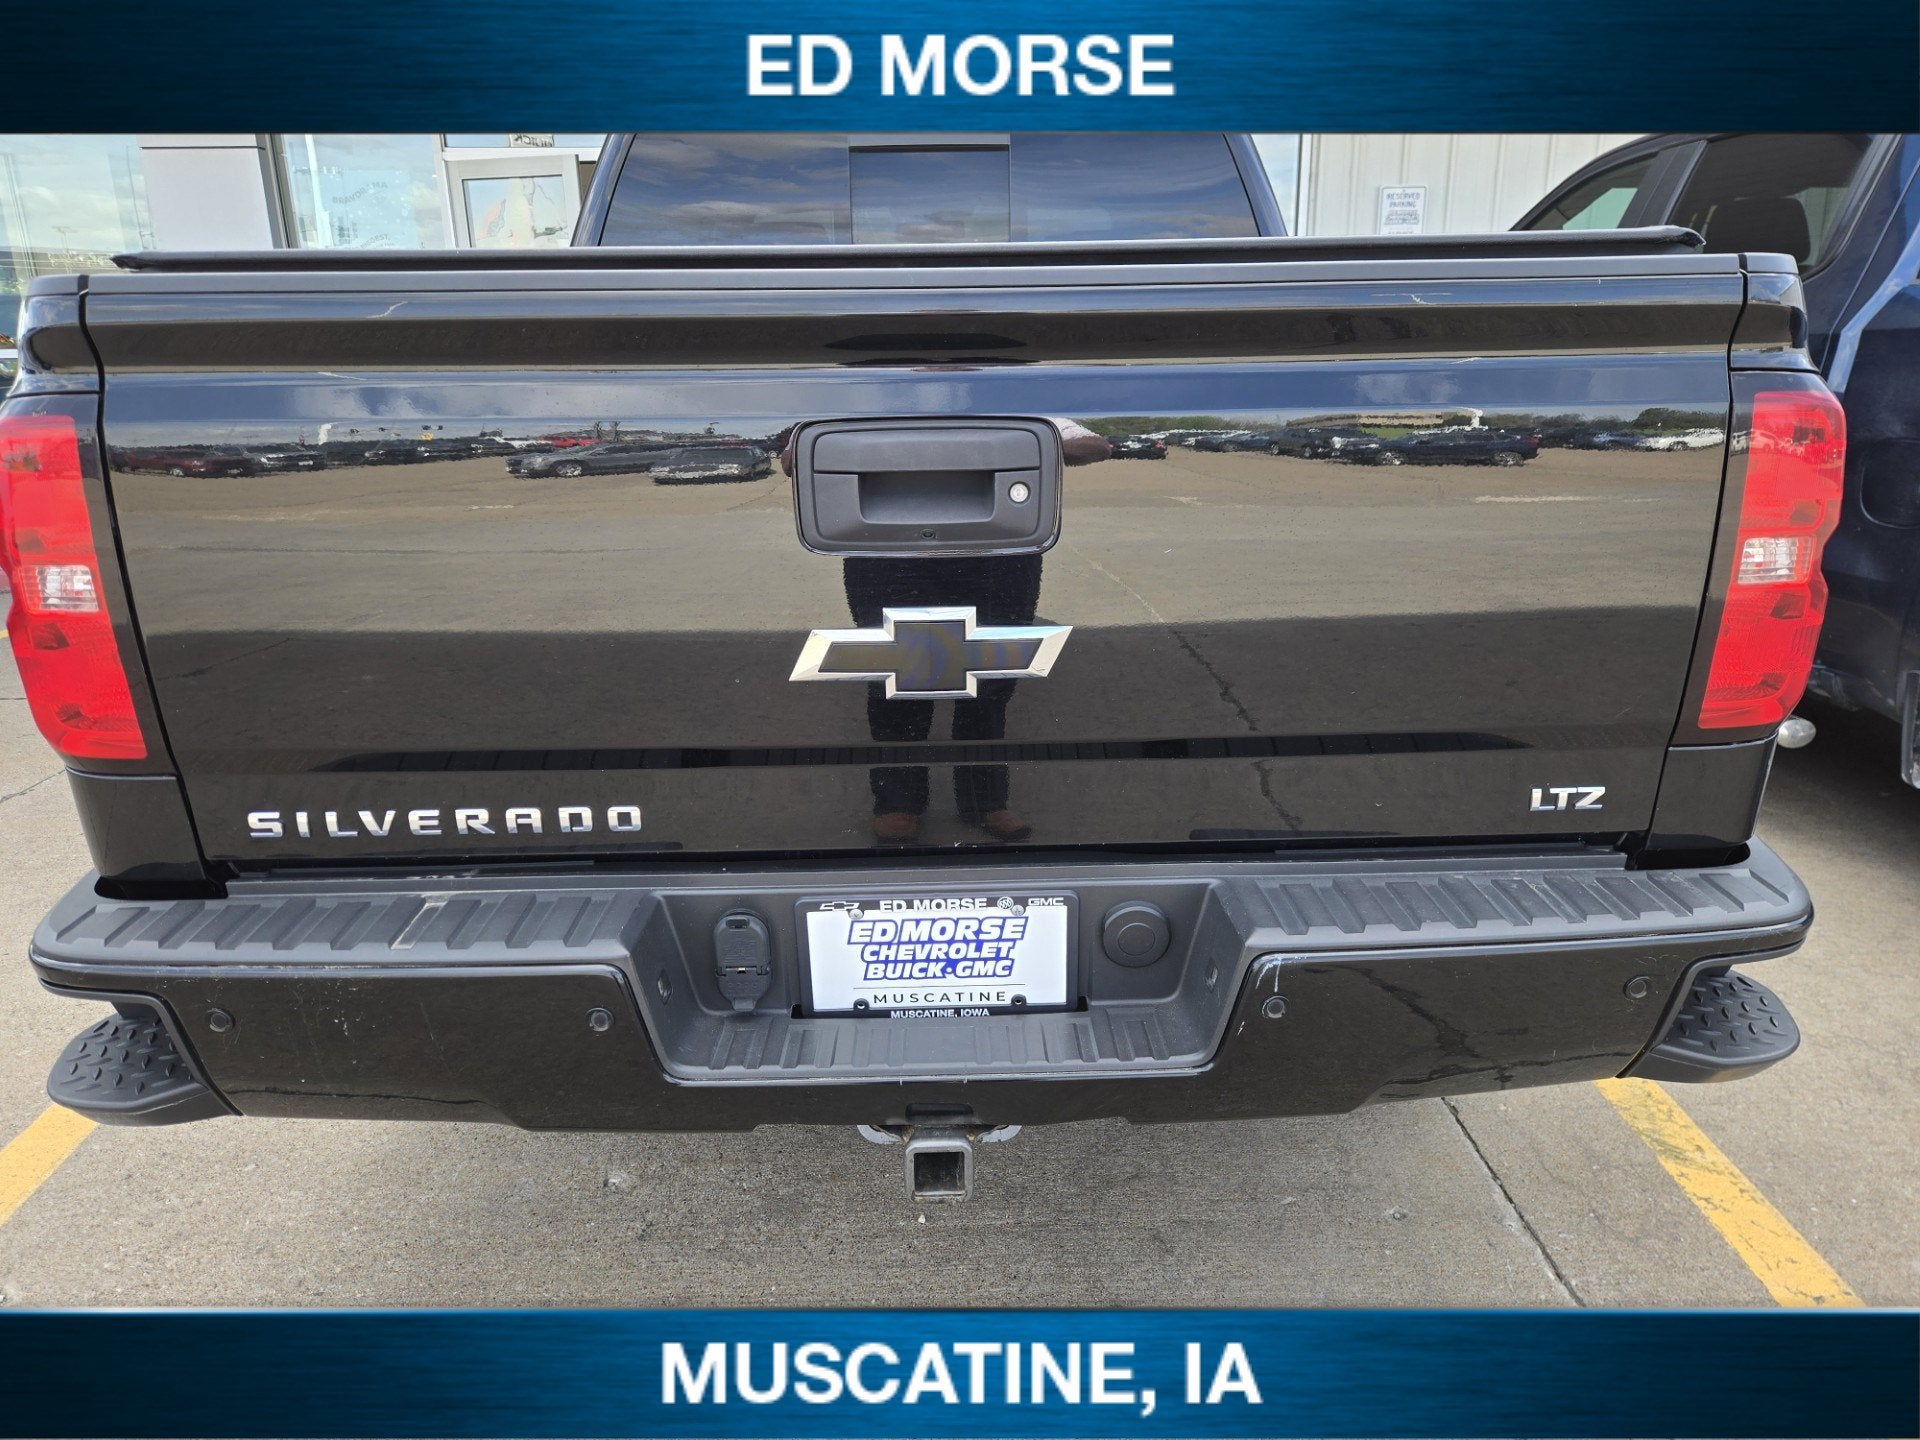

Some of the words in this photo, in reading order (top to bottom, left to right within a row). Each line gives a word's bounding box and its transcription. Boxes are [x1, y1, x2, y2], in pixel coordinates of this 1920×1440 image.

[1530, 786, 1606, 812] LTZ
[247, 806, 643, 838] SILVERADO
[879, 899, 907, 912] ED
[913, 897, 987, 912] MORSE
[1028, 897, 1064, 906] GMC
[848, 919, 898, 944] ED
[899, 916, 1028, 941] MORSE
[861, 941, 1015, 962] CHEVROLET
[873, 991, 1006, 1004] MUSCATINE
[890, 1009, 957, 1019] MUSCATINE,
[960, 1008, 990, 1017] IOWA
